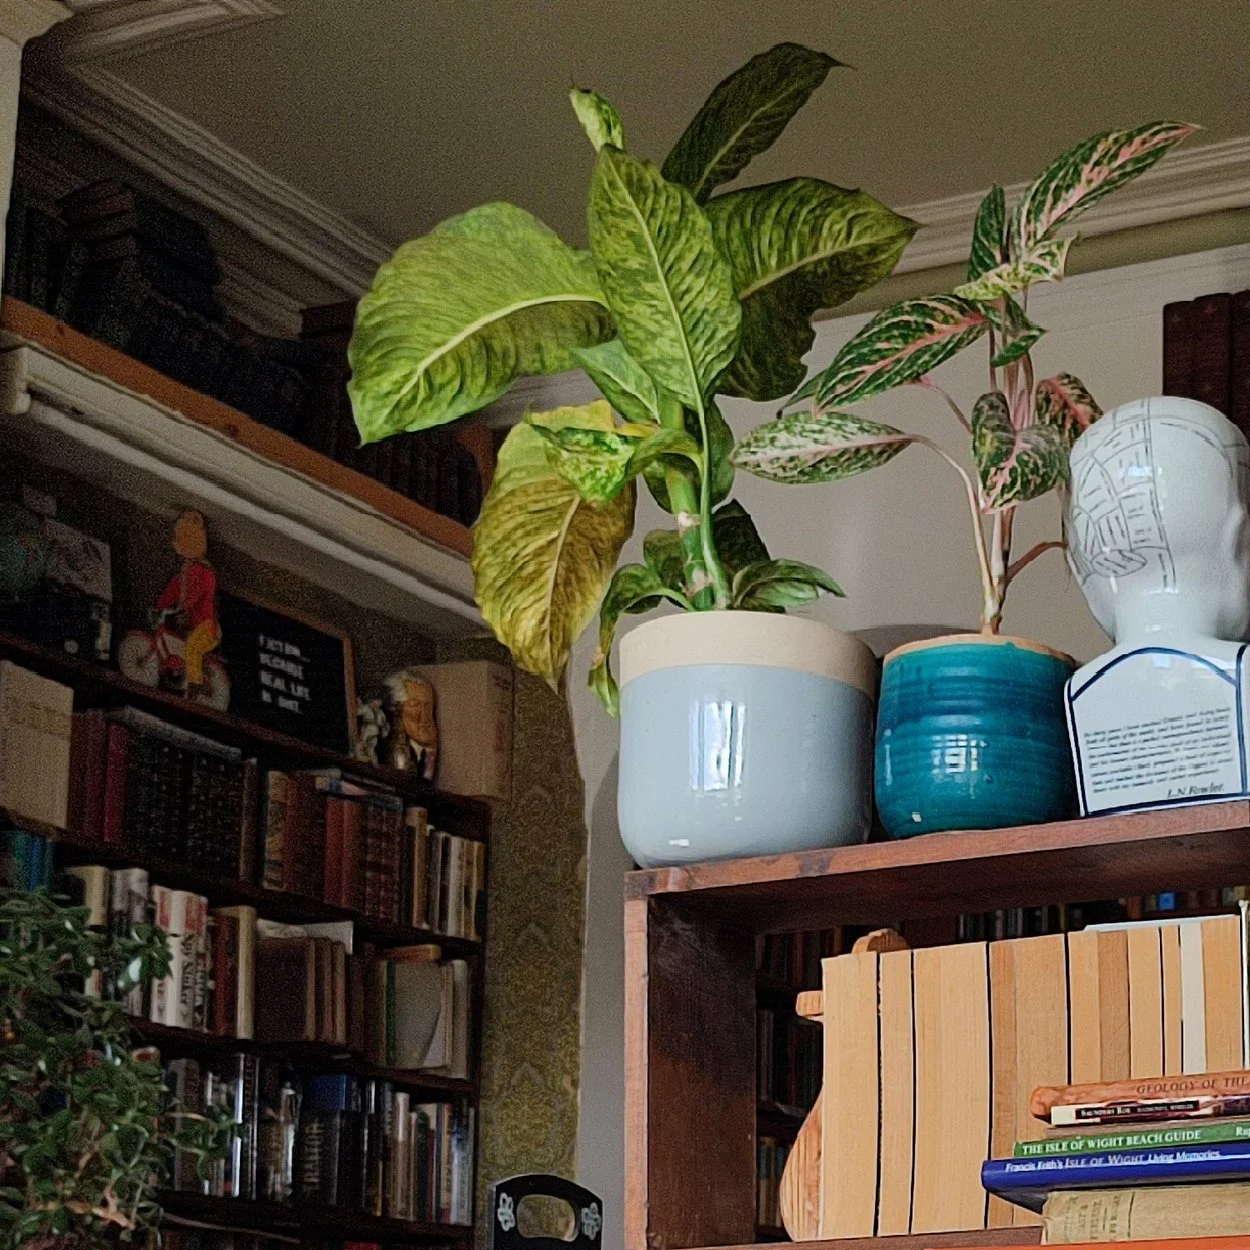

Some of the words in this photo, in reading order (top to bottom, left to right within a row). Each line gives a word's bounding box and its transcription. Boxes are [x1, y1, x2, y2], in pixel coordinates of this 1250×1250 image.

[1136, 1081, 1196, 1095] GEOLOGY
[1202, 1079, 1216, 1090] OF
[1224, 1076, 1250, 1088] THE
[1022, 1143, 1044, 1155] THE
[1045, 1141, 1068, 1153] ISLE
[1071, 1140, 1084, 1151] OF
[1087, 1136, 1124, 1149] WIGHT
[1126, 1133, 1163, 1146] BEACH
[1165, 1130, 1201, 1142] GUIDE
[1005, 1160, 1036, 1173] Francis
[1037, 1158, 1064, 1171] Frith's
[1065, 1155, 1087, 1168] ISLE
[1107, 1153, 1145, 1166] WIGHT
[1148, 1152, 1174, 1164] Living
[1175, 1150, 1221, 1162] Memories
